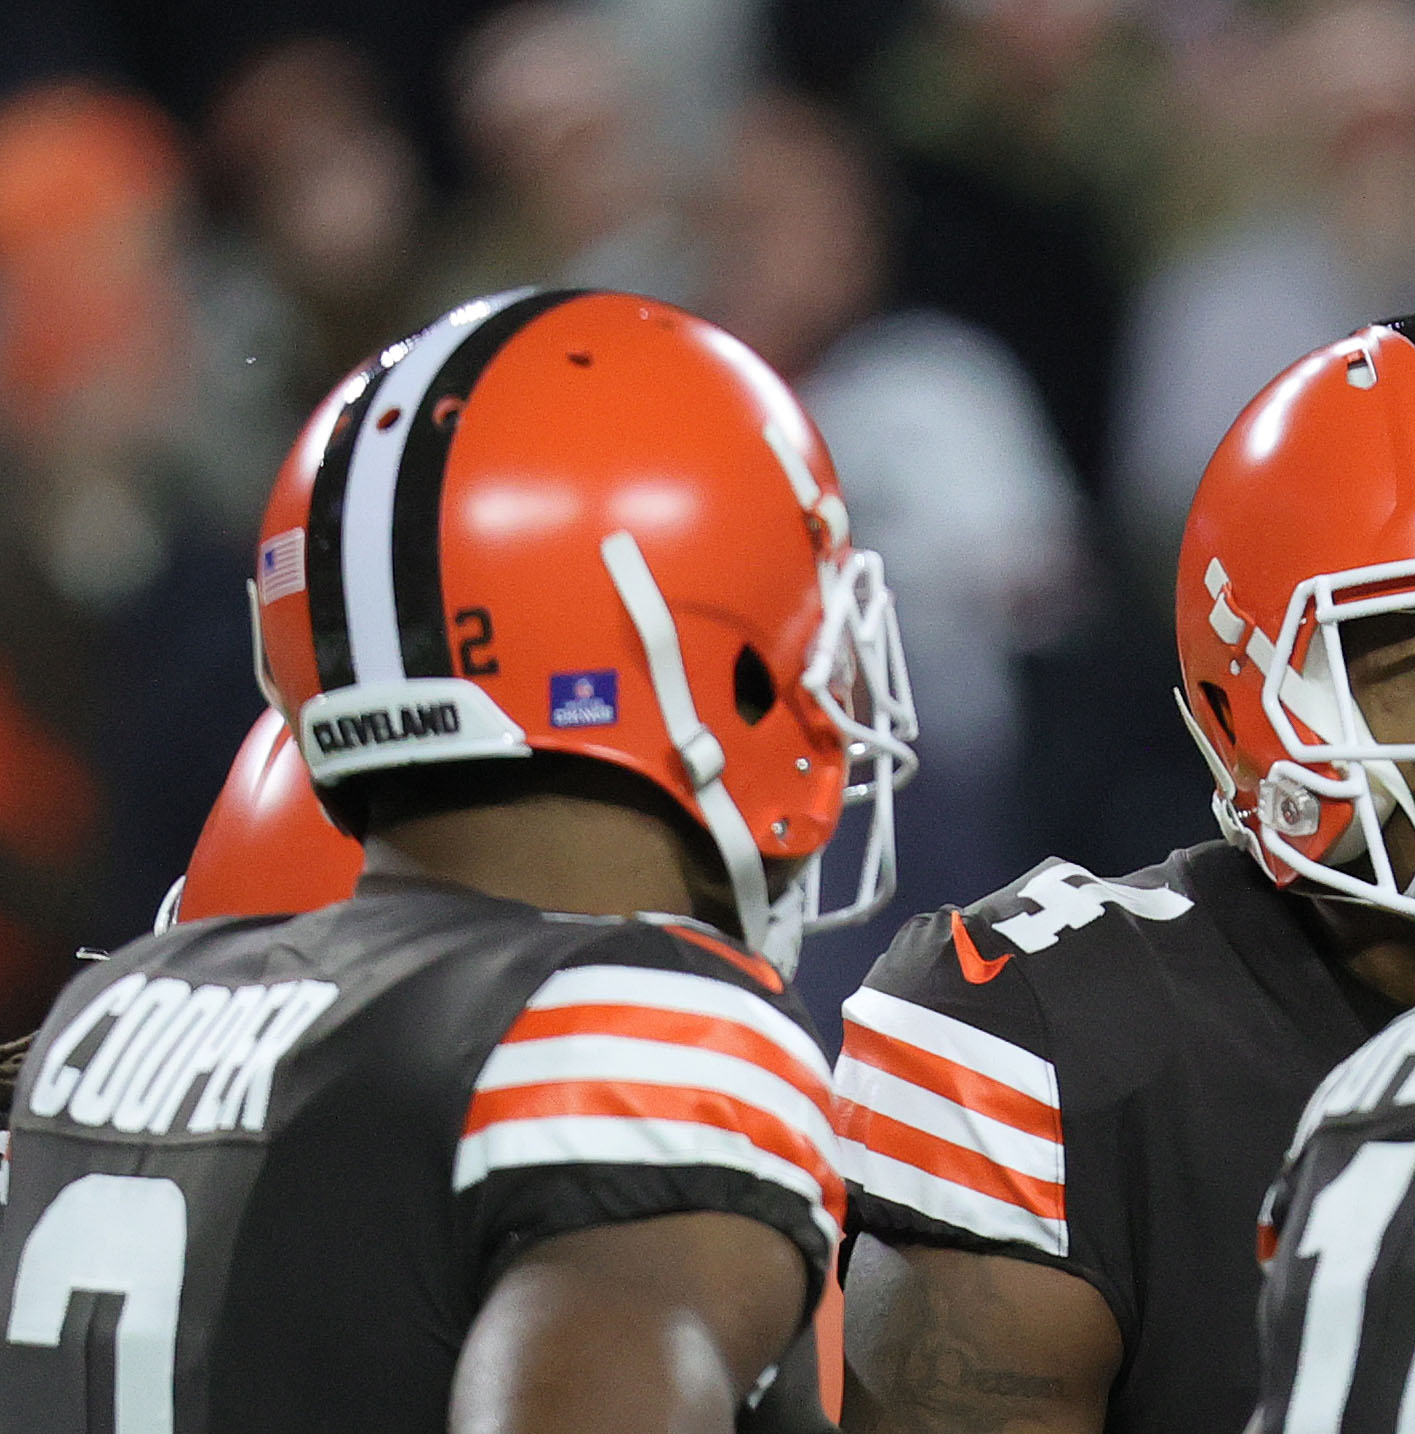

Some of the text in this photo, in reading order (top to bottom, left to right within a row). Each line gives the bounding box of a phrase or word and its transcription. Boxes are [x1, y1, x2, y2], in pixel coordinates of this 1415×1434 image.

[454, 605, 500, 677] 2
[311, 700, 461, 755] CLEVELAND
[29, 971, 340, 1136] COOPER
